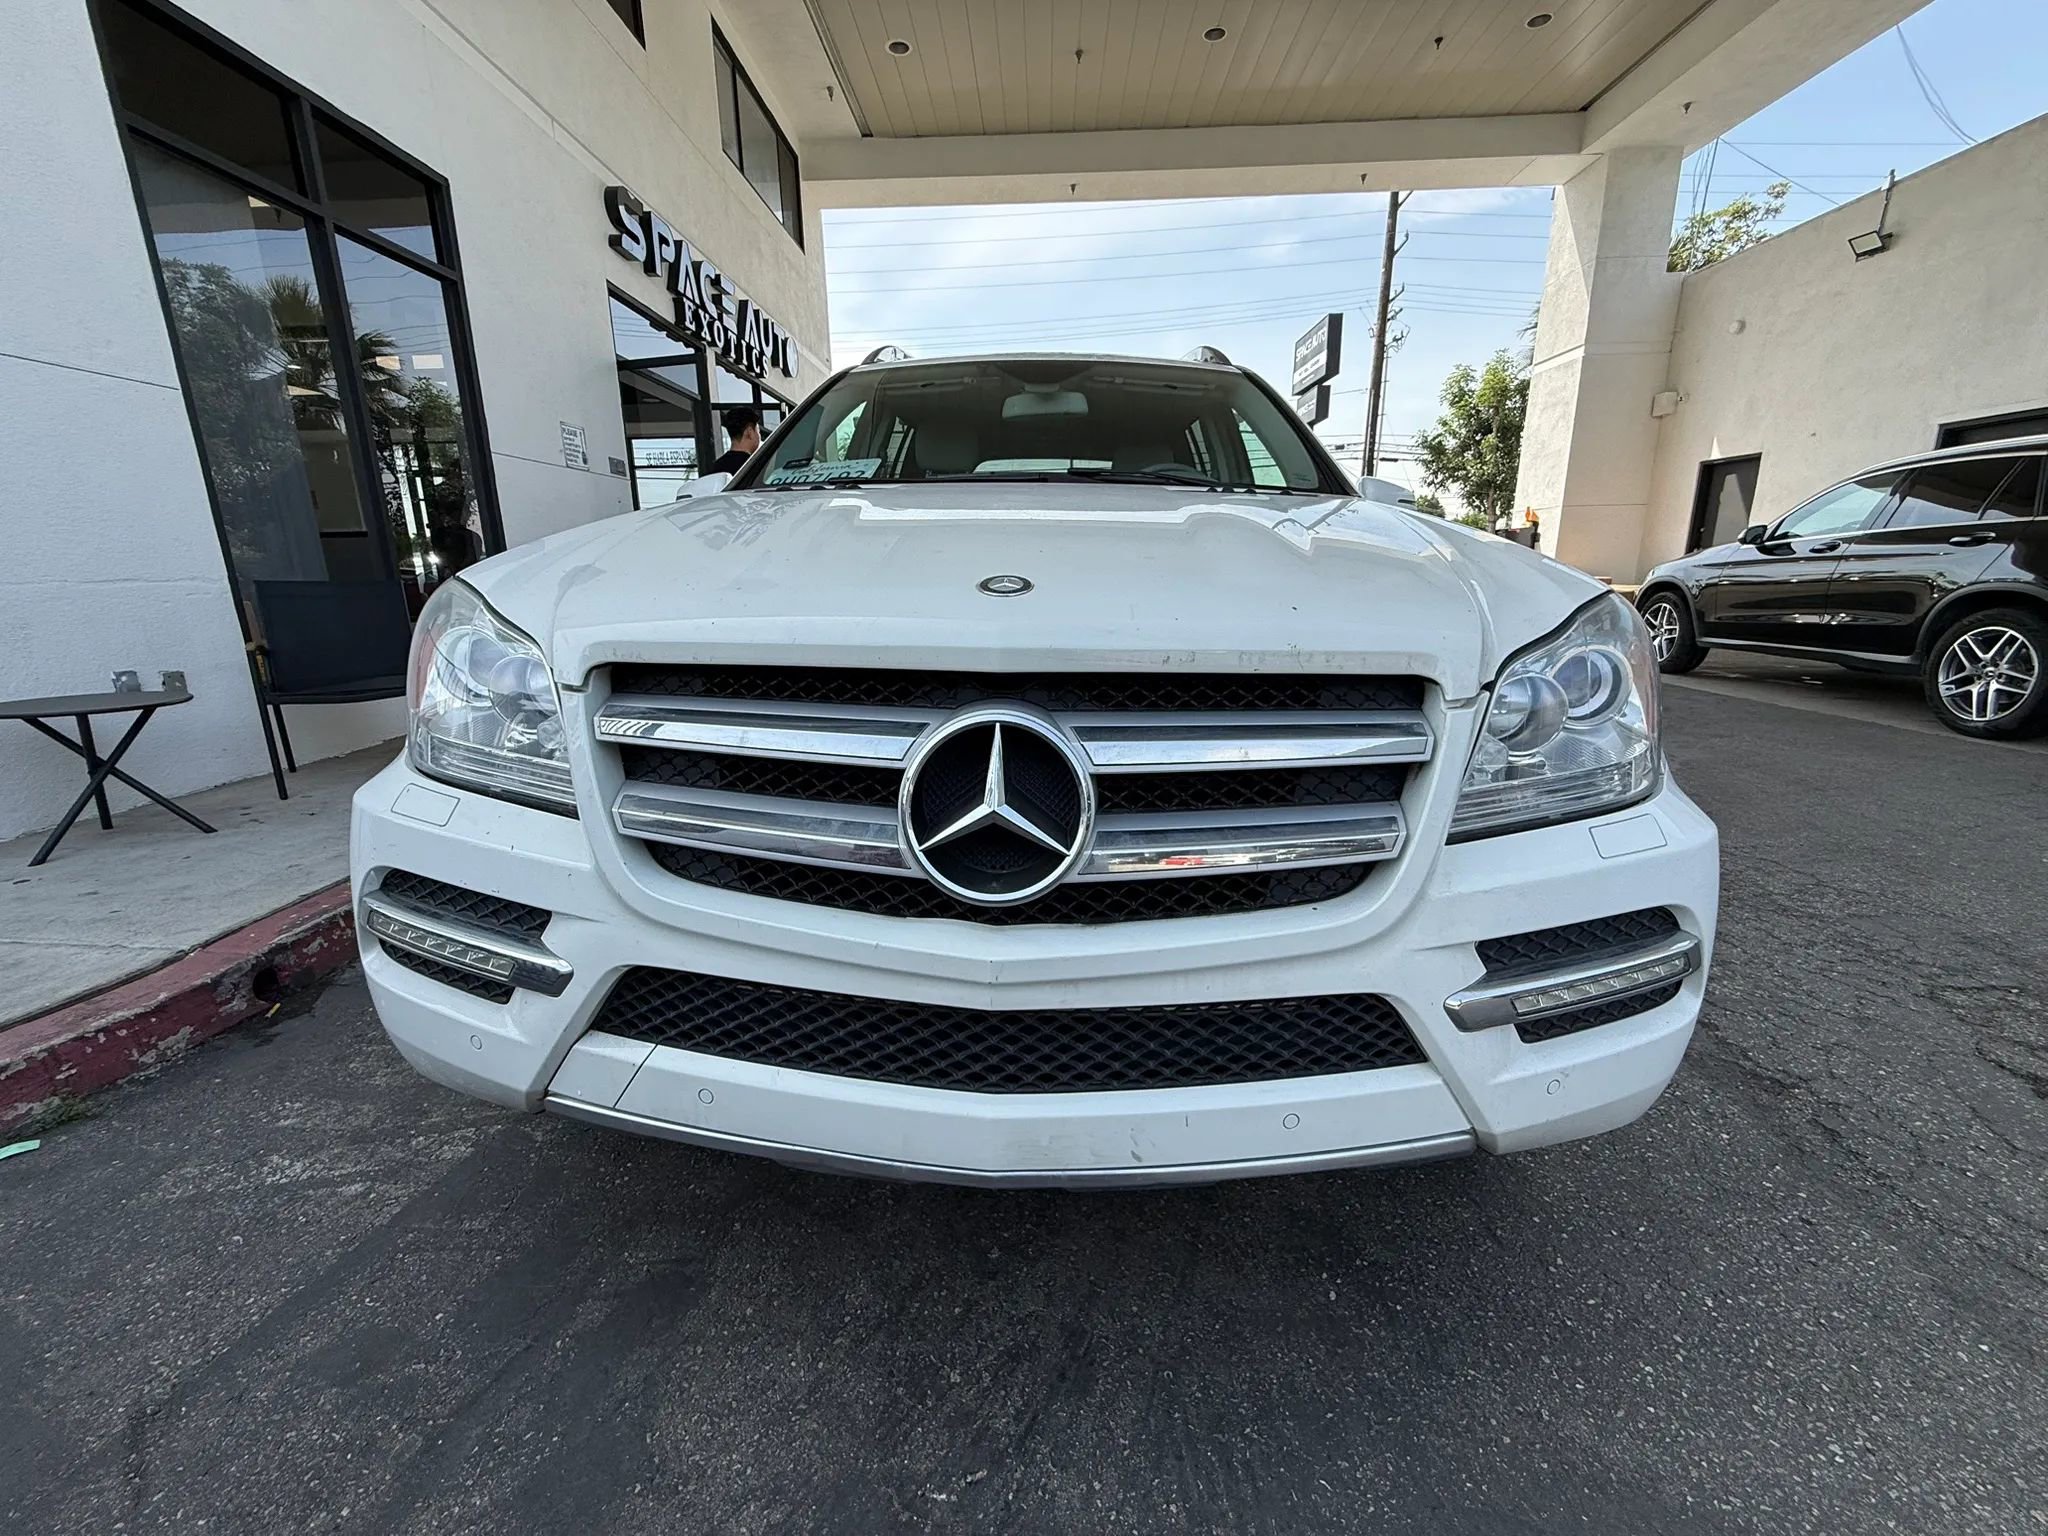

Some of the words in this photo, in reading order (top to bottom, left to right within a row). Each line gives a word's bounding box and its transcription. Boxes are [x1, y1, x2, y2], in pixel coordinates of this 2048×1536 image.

[604, 186, 738, 335] SPACE
[739, 299, 799, 378] AUTO
[676, 297, 769, 379] EXOTICS
